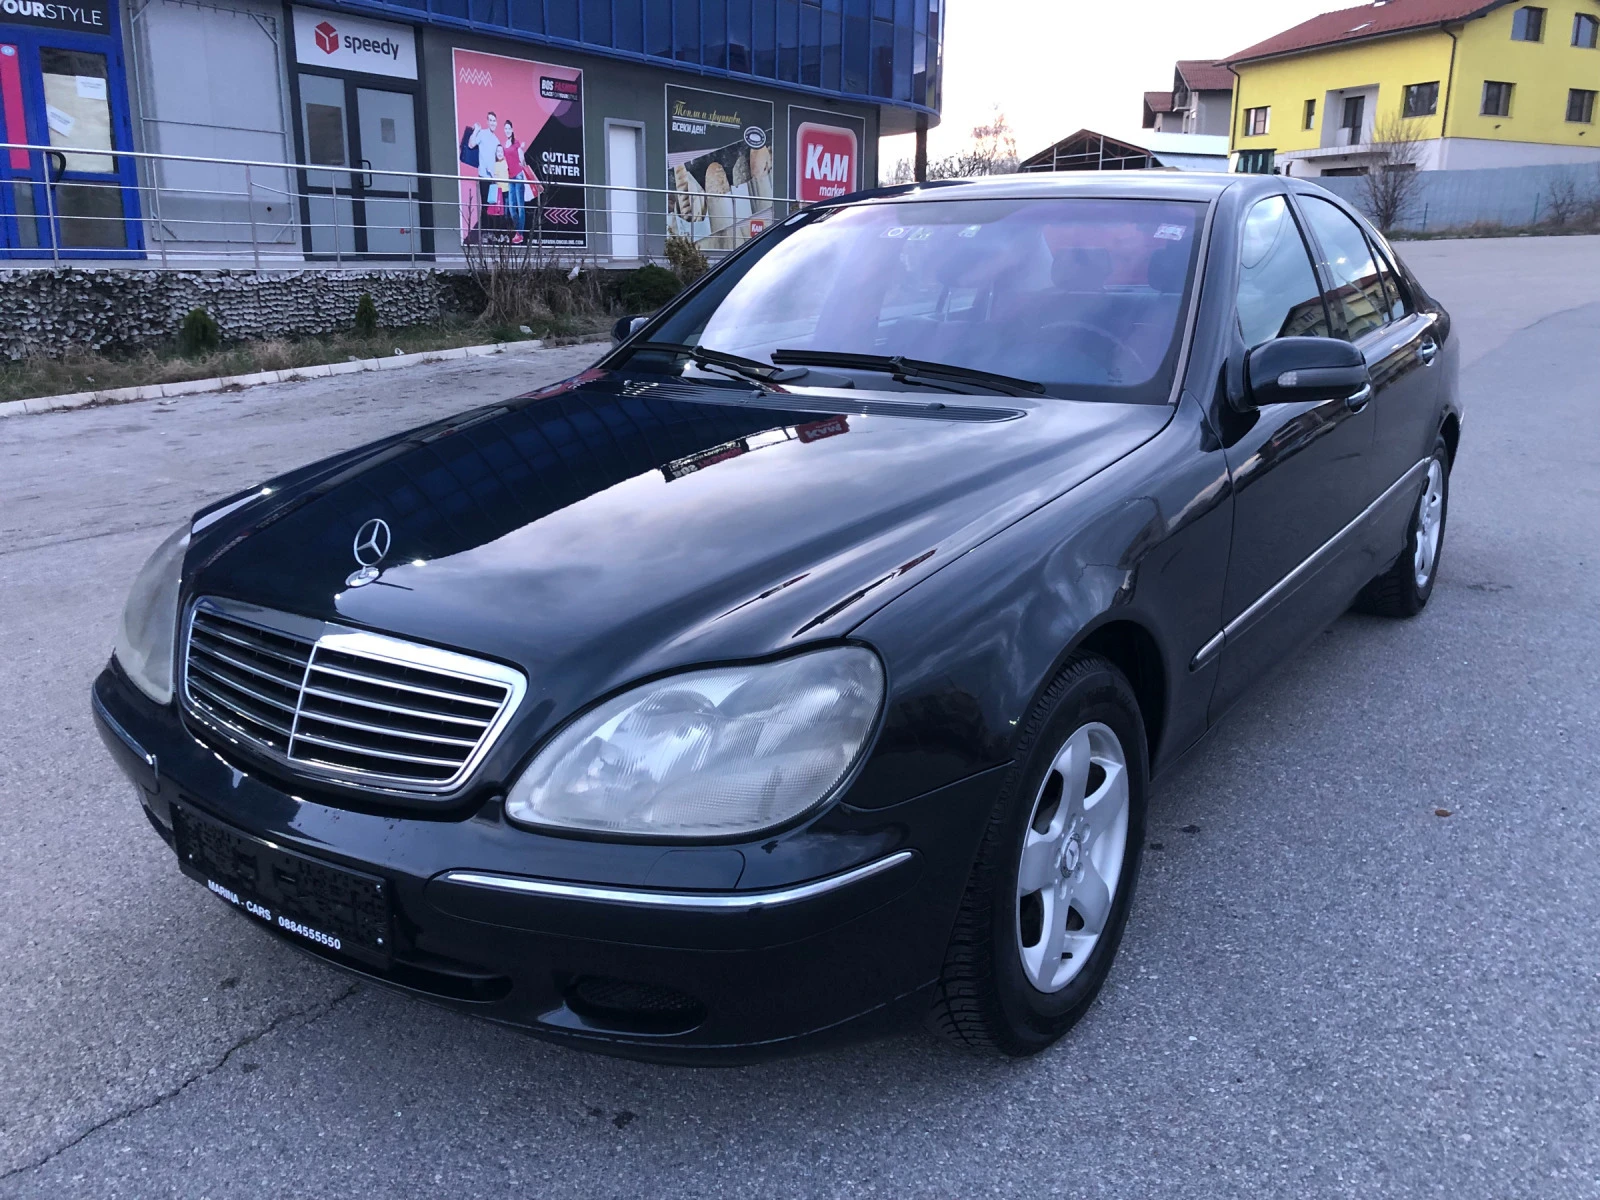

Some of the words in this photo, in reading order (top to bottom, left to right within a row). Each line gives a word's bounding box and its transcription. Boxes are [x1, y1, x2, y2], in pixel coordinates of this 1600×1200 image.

[0, 0, 103, 26] OURSTYLE
[344, 35, 399, 60] speedy
[541, 151, 580, 165] OUTLET
[542, 164, 580, 177] CENTER
[805, 143, 849, 183] KAM
[819, 184, 846, 197] market
[207, 879, 239, 904] MARINA
[246, 900, 272, 920] CARS
[278, 916, 341, 950] 0884555550
